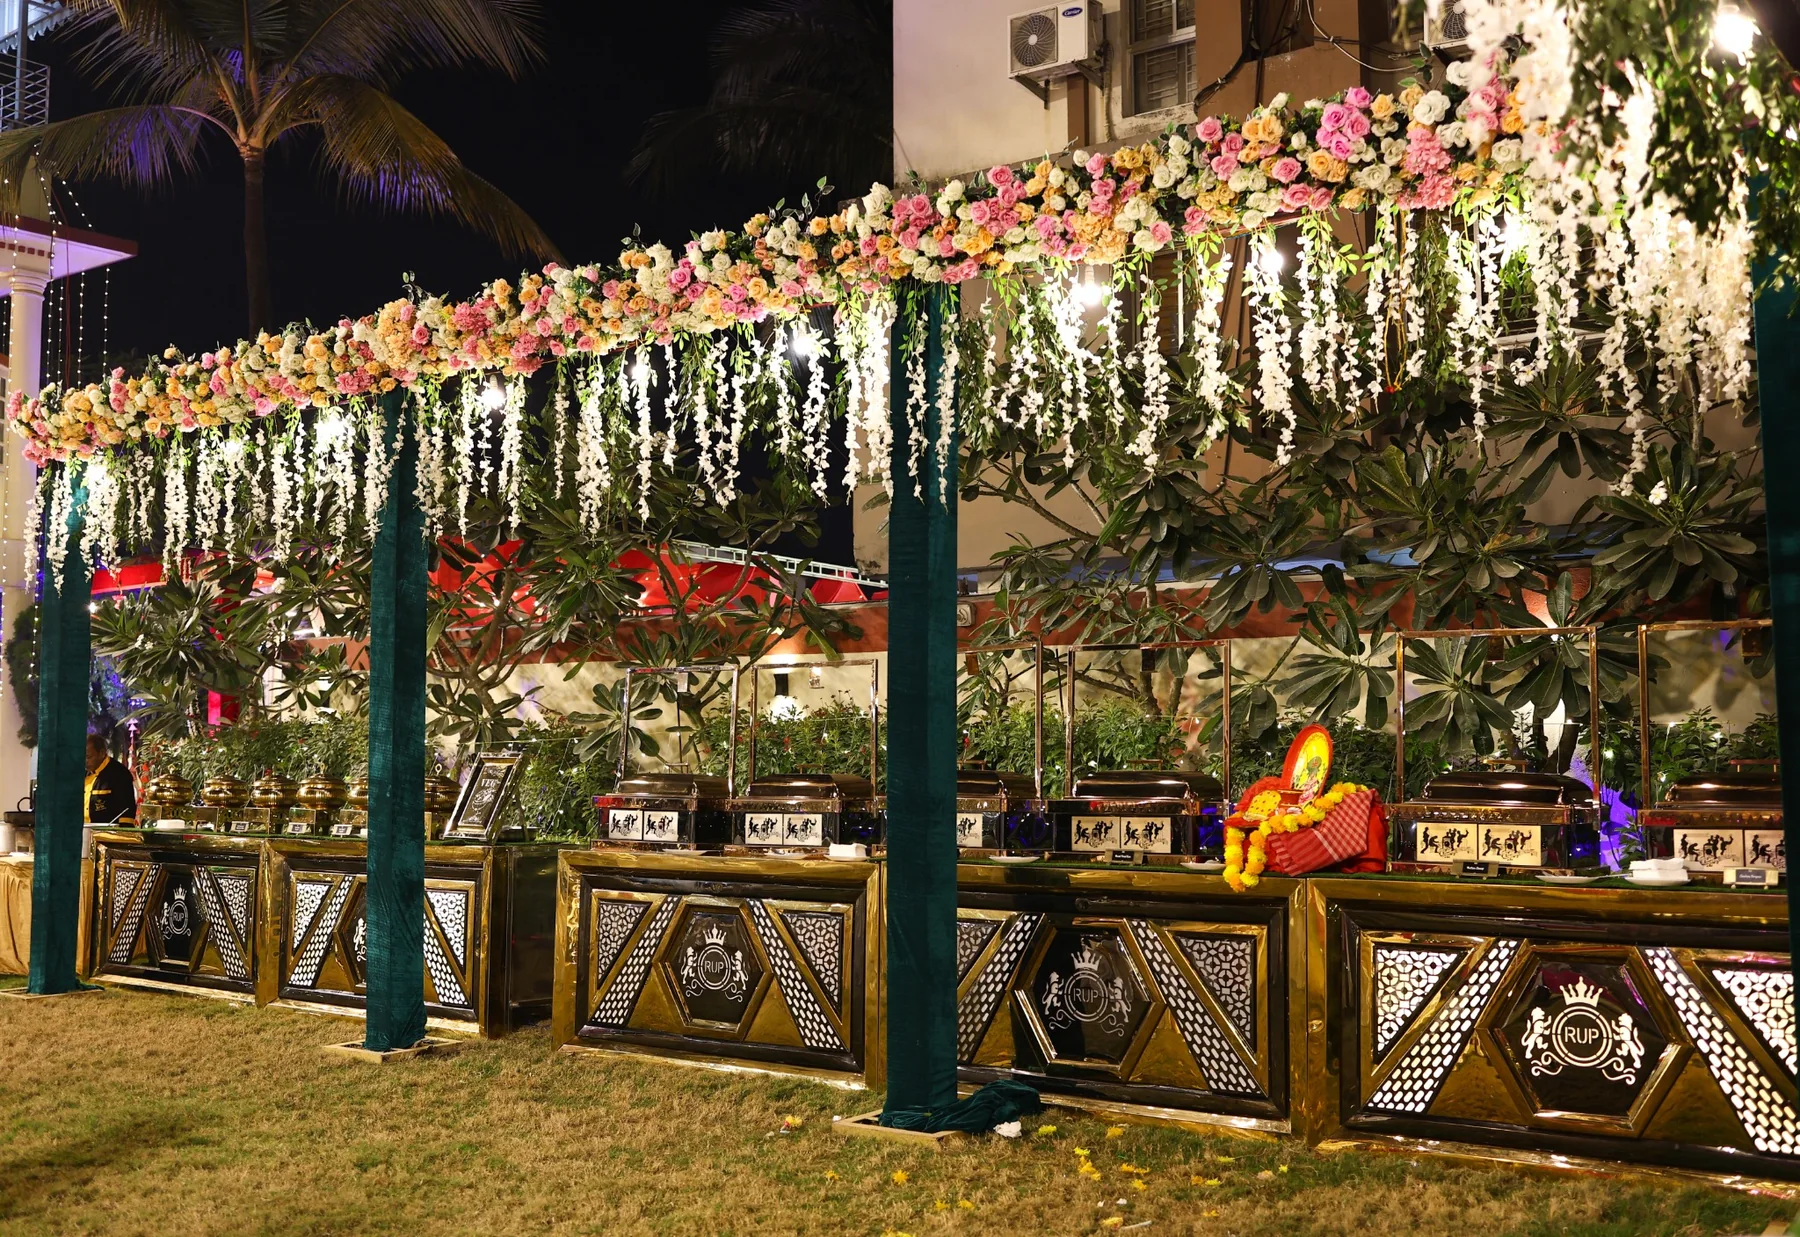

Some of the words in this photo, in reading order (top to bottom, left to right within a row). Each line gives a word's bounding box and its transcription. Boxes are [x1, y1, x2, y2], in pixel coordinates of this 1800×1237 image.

[704, 960, 725, 974] RUP
[1073, 988, 1099, 1003] RUP
[1564, 1026, 1600, 1045] RUP
